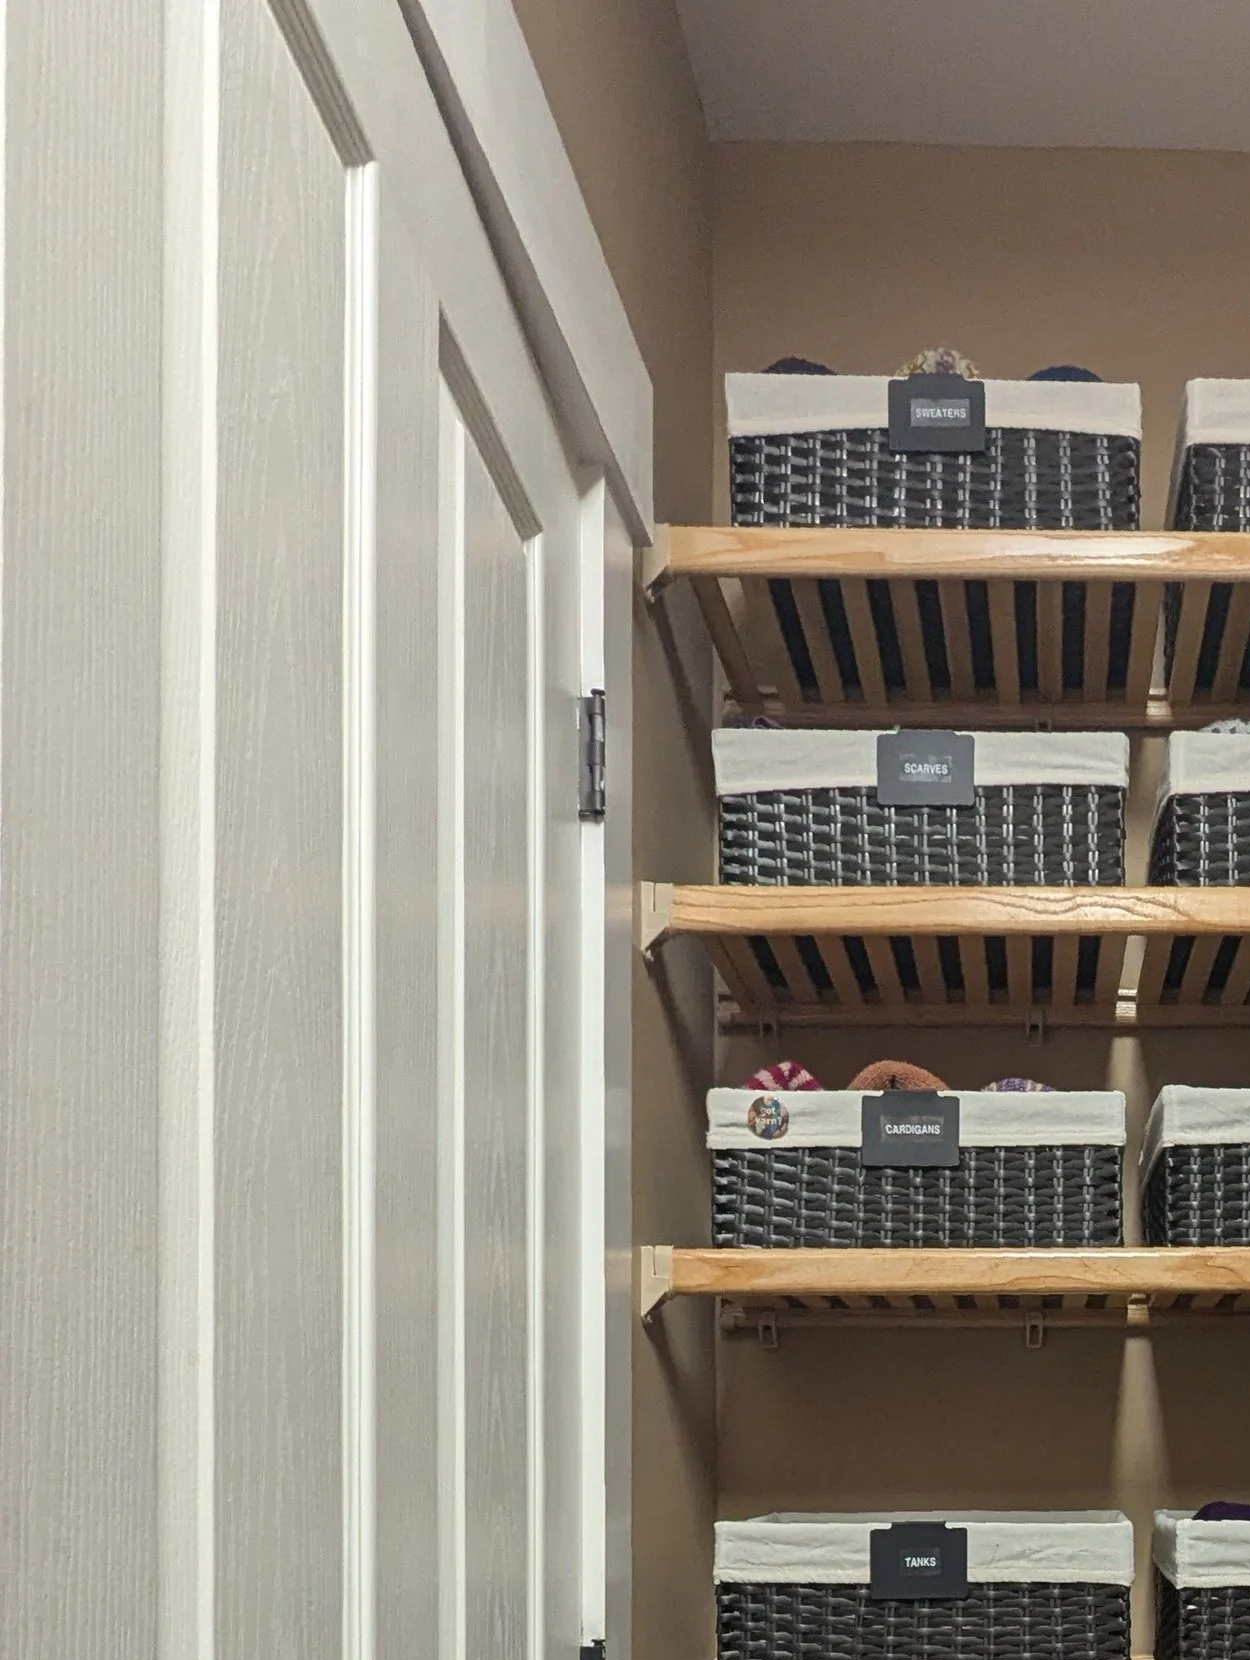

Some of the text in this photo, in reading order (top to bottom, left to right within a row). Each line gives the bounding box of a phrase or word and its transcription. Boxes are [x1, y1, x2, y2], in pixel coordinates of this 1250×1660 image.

[915, 408, 967, 418] SWEATERS
[904, 763, 949, 775] SCARVES
[885, 1124, 941, 1136] CARDIGANS
[904, 1556, 937, 1568] TANKS
